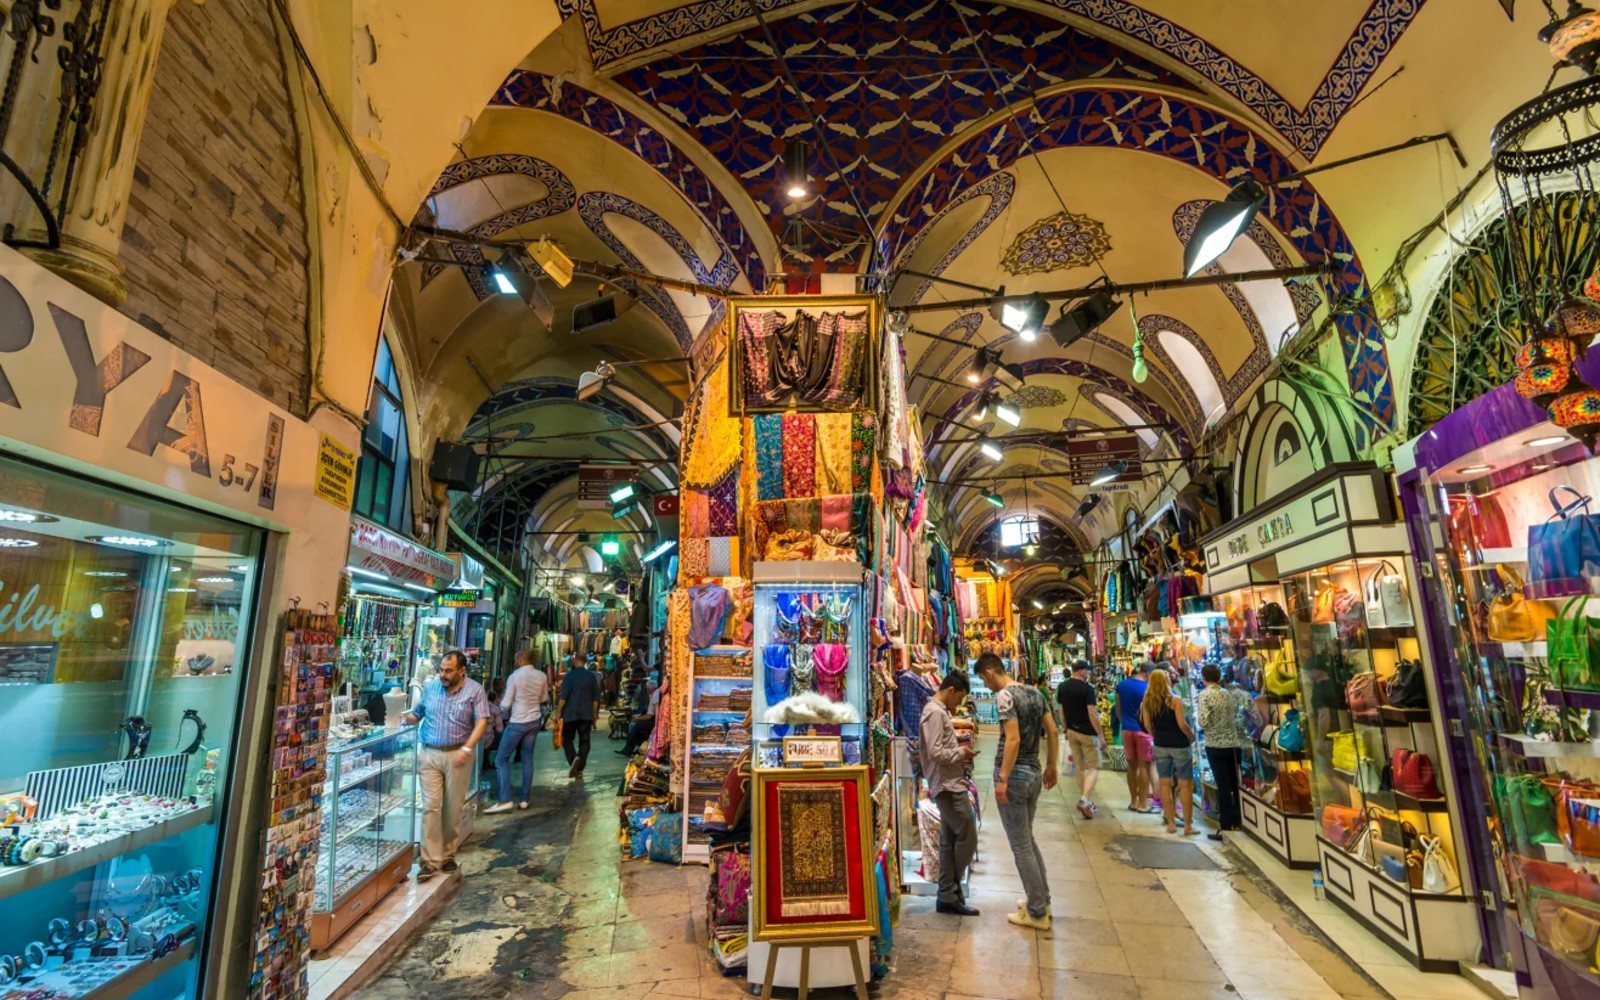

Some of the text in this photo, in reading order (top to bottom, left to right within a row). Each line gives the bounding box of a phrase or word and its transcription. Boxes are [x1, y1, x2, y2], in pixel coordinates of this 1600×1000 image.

[219, 453, 259, 492] 5-7
[262, 422, 279, 499] SILVER
[789, 743, 813, 756] PURE
